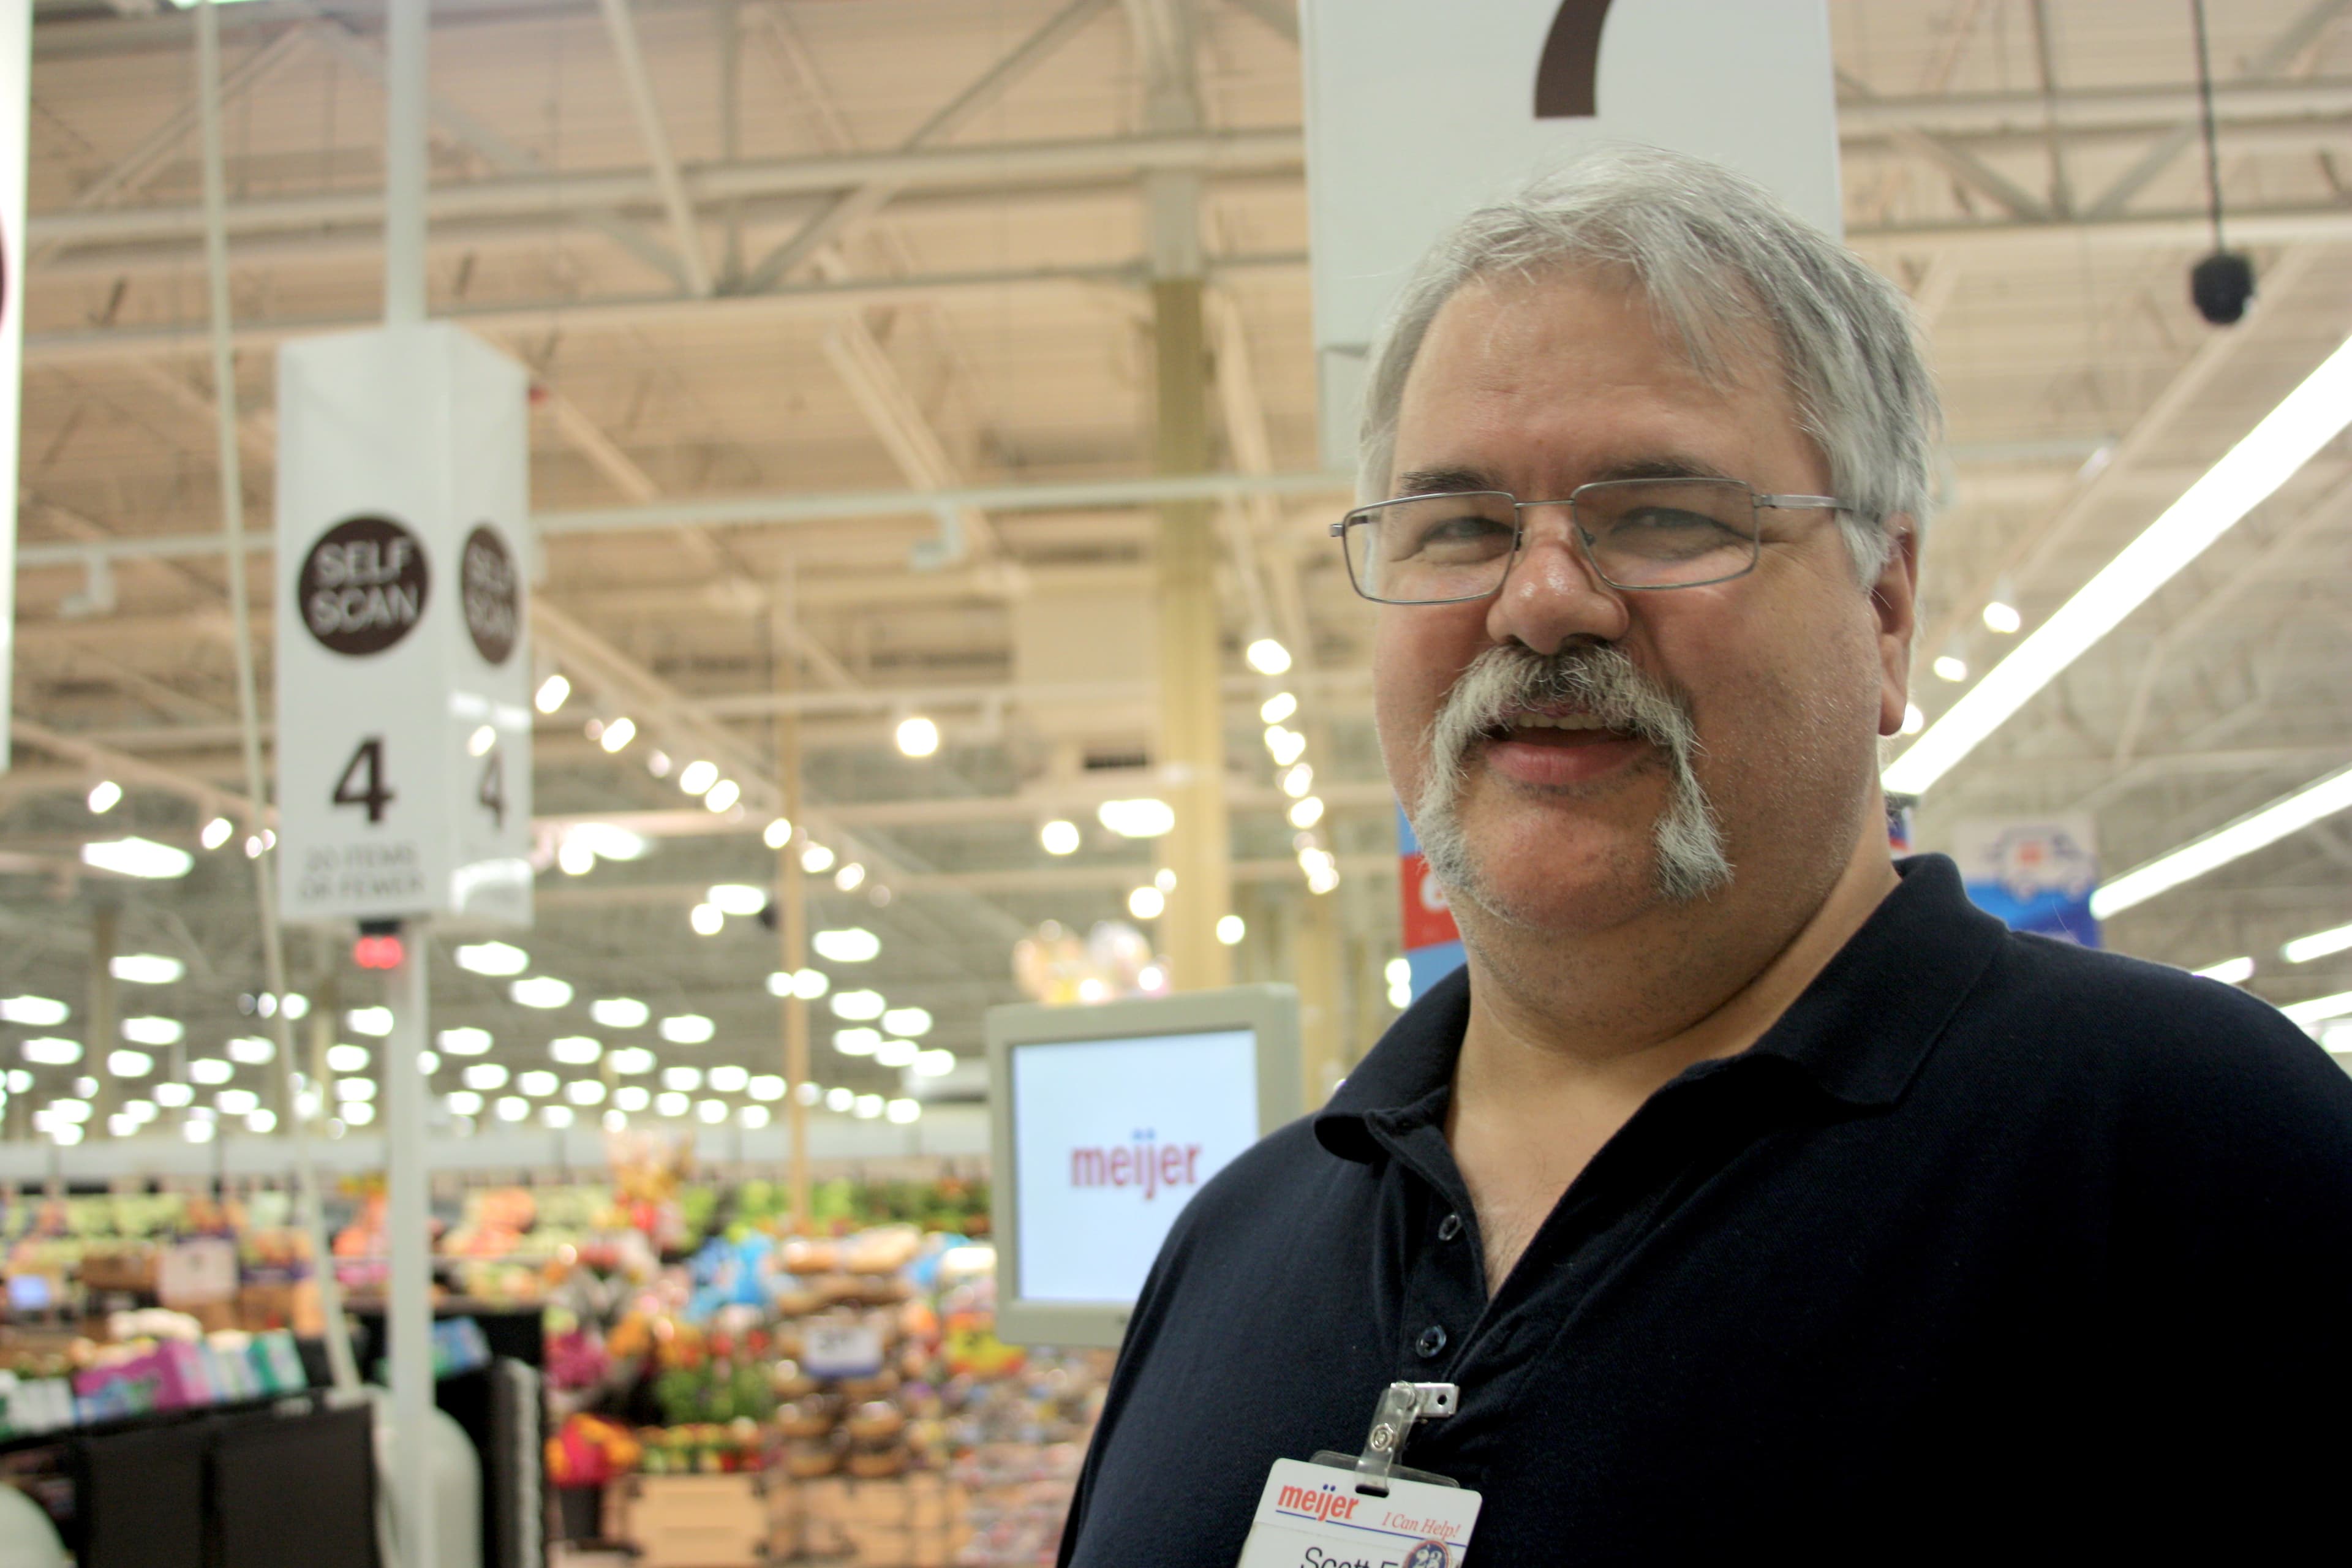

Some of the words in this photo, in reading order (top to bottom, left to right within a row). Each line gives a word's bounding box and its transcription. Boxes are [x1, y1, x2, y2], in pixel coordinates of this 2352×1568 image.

[314, 536, 415, 587] SELF
[311, 582, 419, 636] SCAN
[331, 734, 396, 824] 4
[478, 747, 507, 831] 4
[1070, 1128, 1200, 1200] meijer
[1278, 1483, 1359, 1522] meijer
[1382, 1512, 1392, 1526] I
[1392, 1513, 1419, 1531] Can
[1420, 1518, 1461, 1541] Help!
